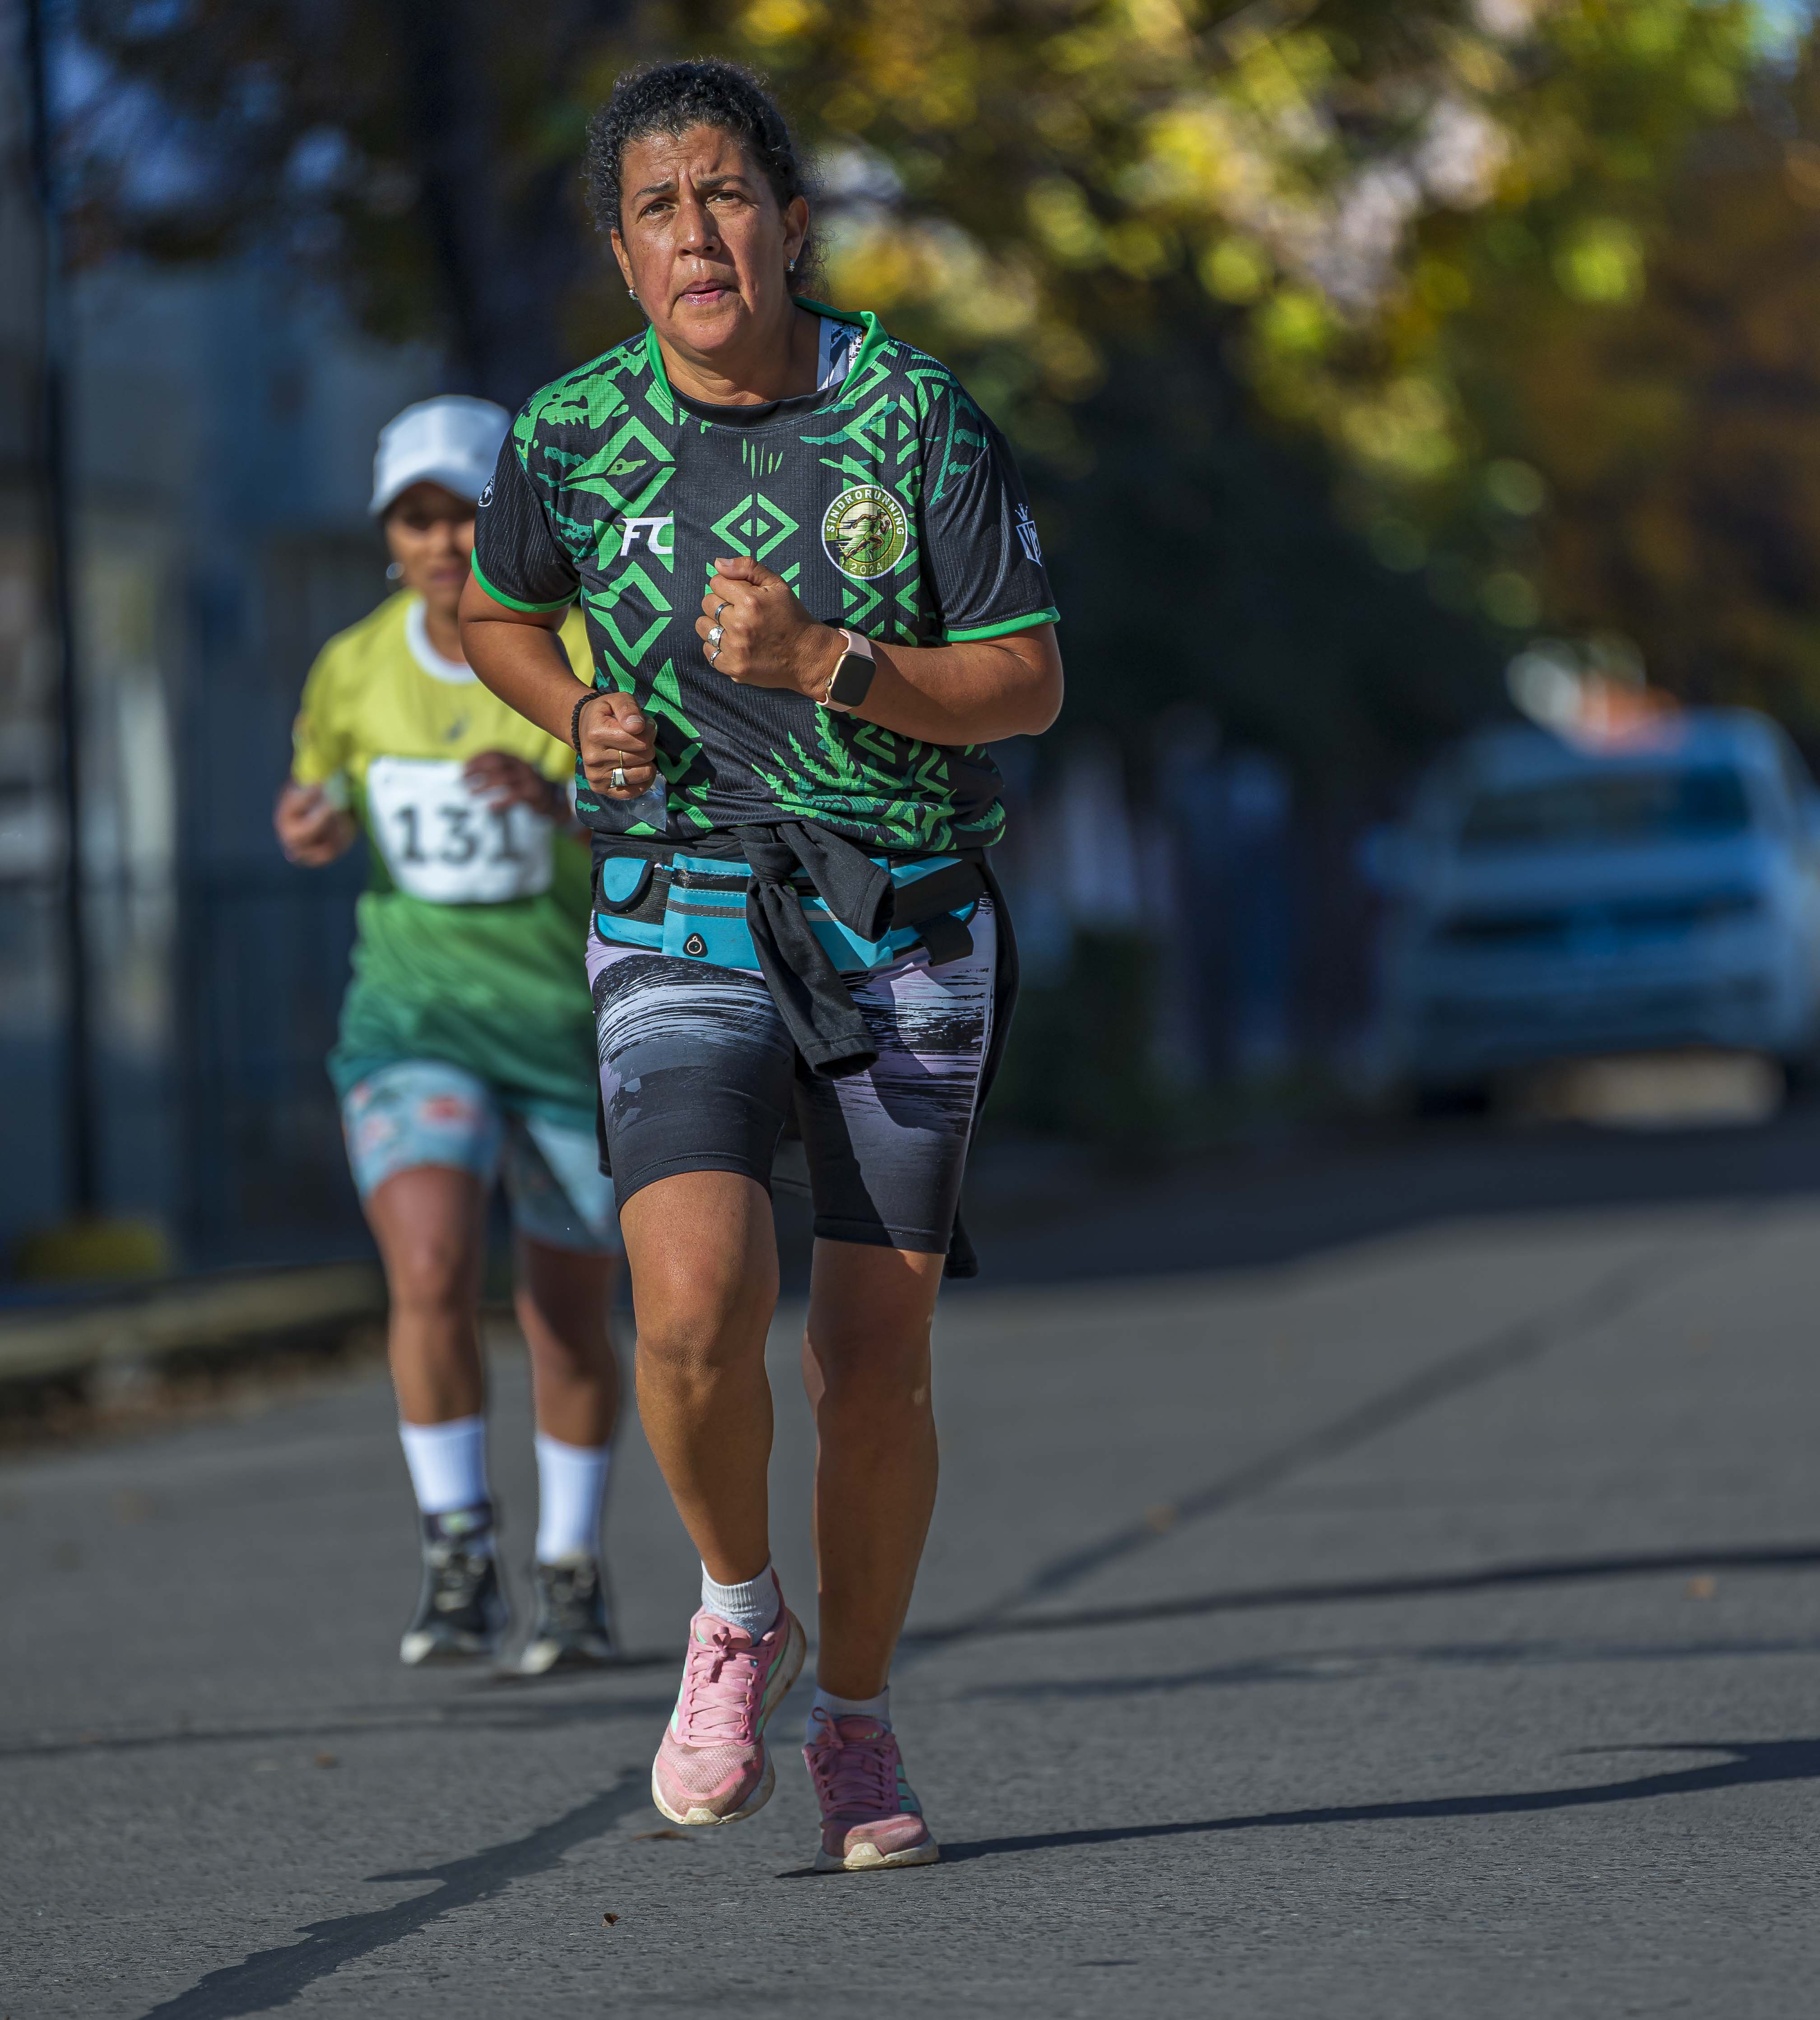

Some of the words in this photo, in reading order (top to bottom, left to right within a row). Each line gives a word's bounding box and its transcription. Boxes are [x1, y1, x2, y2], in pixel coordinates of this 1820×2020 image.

[826, 489, 905, 535] SINDRORUNNING
[620, 517, 673, 556] FC
[850, 562, 883, 574] 2024
[392, 805, 525, 866] 131
